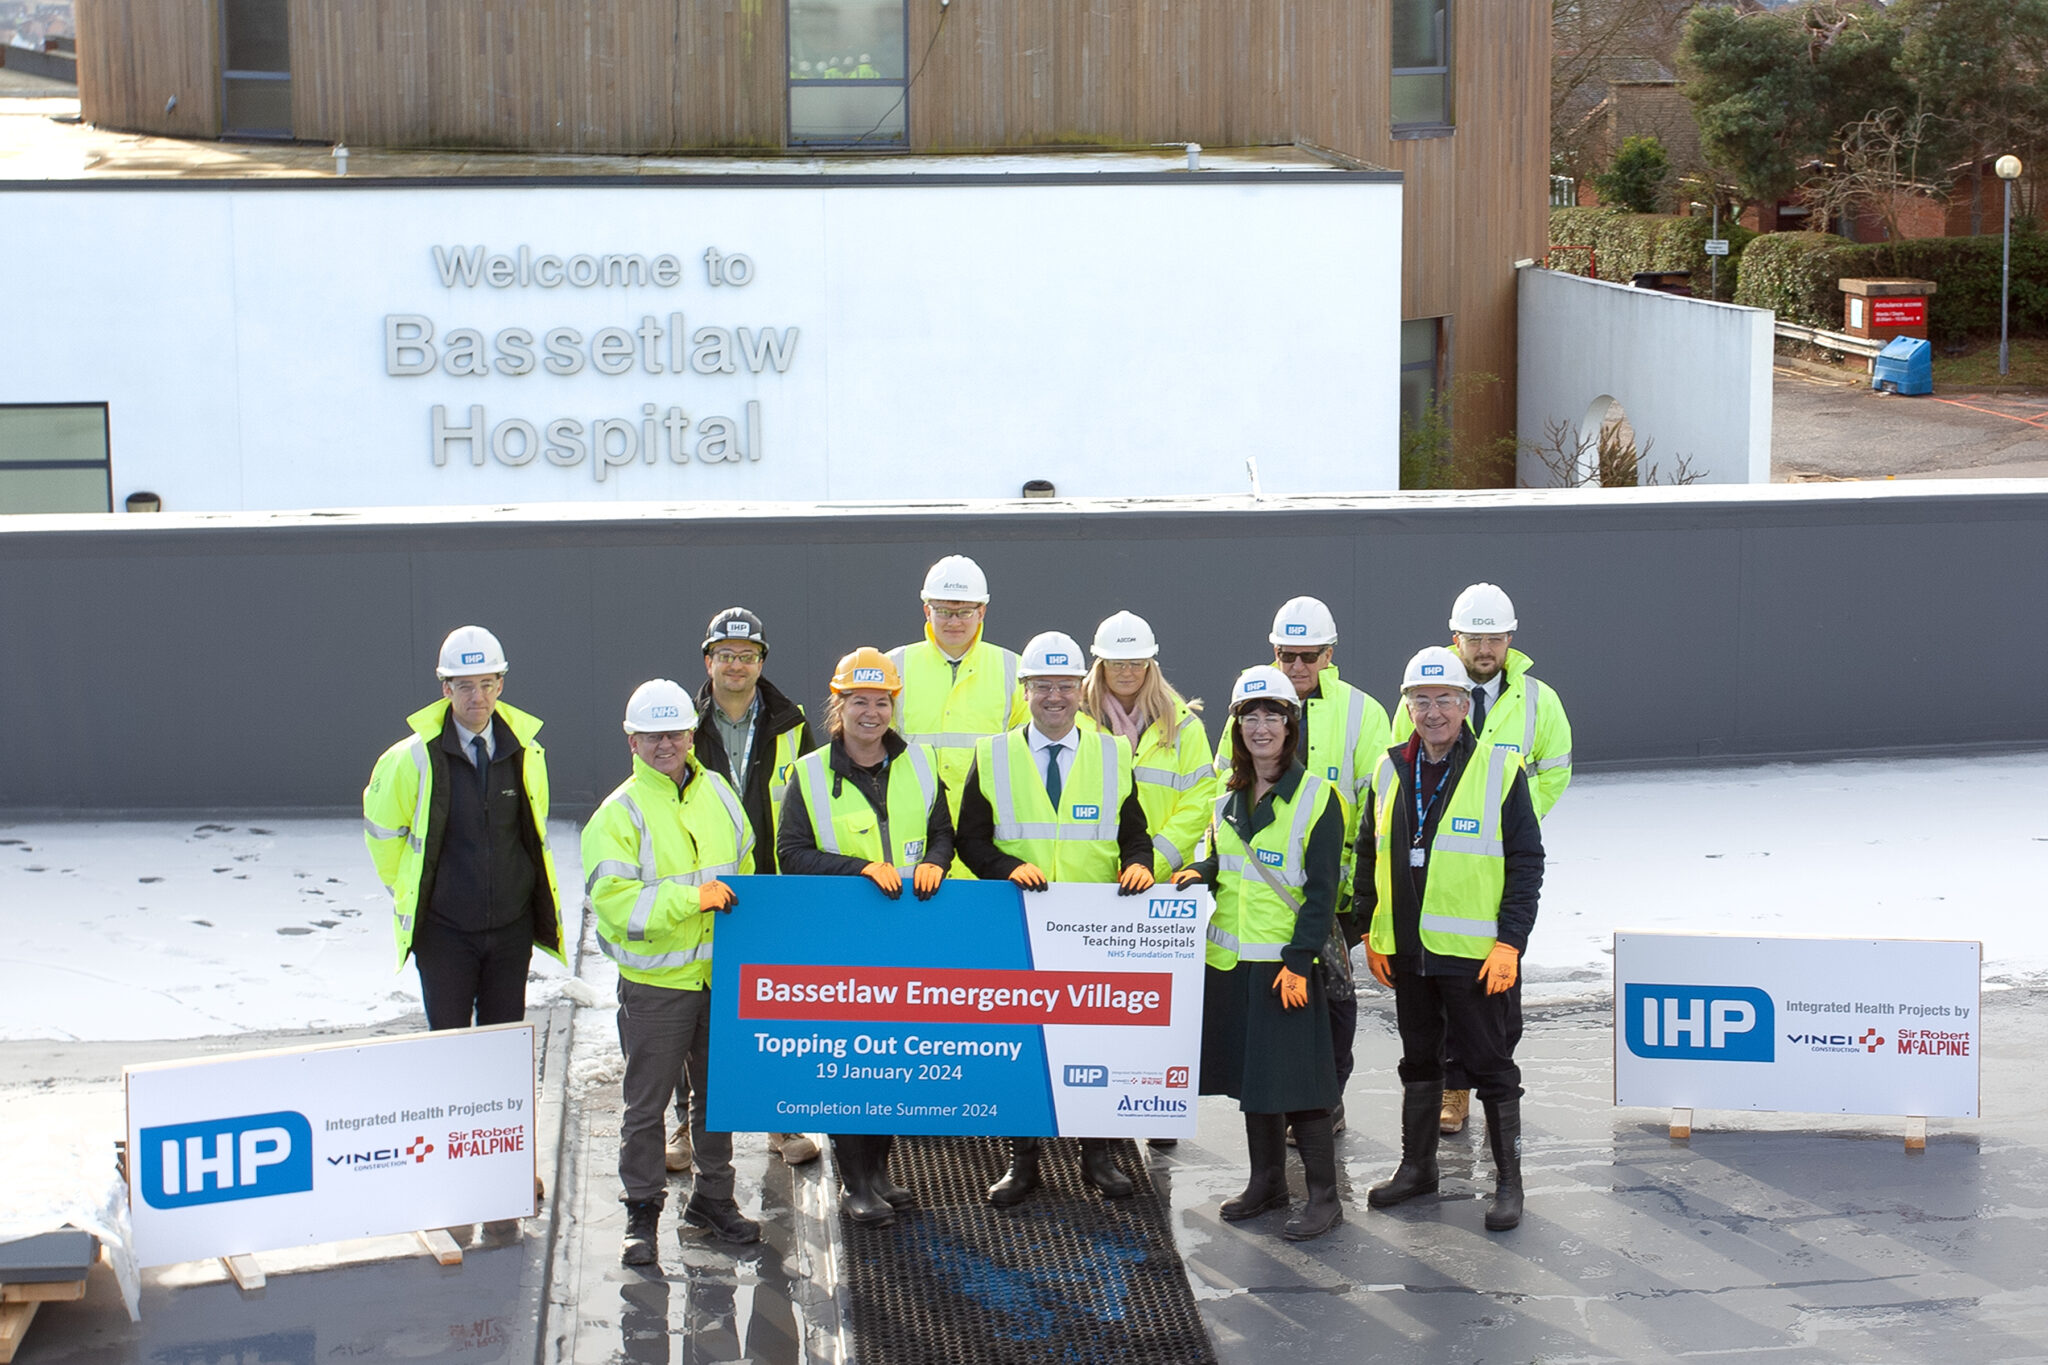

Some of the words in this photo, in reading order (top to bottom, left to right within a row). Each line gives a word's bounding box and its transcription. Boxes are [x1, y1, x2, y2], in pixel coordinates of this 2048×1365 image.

[431, 244, 681, 288] Welcome
[703, 246, 754, 287] to
[384, 312, 799, 376] Bassetlaw
[431, 400, 761, 482] Hospital
[1288, 626, 1305, 635] IHP
[464, 654, 482, 664] IHP
[1049, 655, 1066, 664] IHP
[855, 670, 883, 682] NHS
[1424, 666, 1442, 676] IHP
[1246, 682, 1264, 691] IHP
[652, 706, 678, 718] NHS
[1075, 806, 1097, 818] IHP
[1455, 820, 1477, 831] IHP
[1259, 851, 1281, 864] IHP
[1150, 900, 1196, 918] NHS
[1046, 920, 1108, 932] Doncaster
[1110, 922, 1134, 934] and
[1136, 922, 1196, 934] Bassetlaw
[1083, 935, 1136, 950] Teaching
[1140, 937, 1196, 950] Hospitals
[1108, 950, 1125, 958] NHS
[1126, 950, 1173, 958] Foundation
[756, 978, 898, 1004] Bassetlaw
[906, 981, 1060, 1012] Emergency
[1067, 983, 1160, 1013] Village
[1786, 1001, 1850, 1014] Integrated
[1855, 1002, 1895, 1014] Health
[1900, 1004, 1950, 1017] Projects
[1954, 1006, 1970, 1019] by
[1643, 997, 1756, 1049] IHP
[1787, 1034, 1852, 1046] VINCI
[1898, 1029, 1917, 1038] Sir
[1920, 1030, 1970, 1040] Robert
[754, 1033, 847, 1059] Topping
[854, 1034, 897, 1055] Out
[904, 1036, 1022, 1061] Ceremony
[816, 1063, 838, 1079] 19
[843, 1064, 913, 1083] January
[918, 1065, 963, 1080] 2024
[1069, 1068, 1103, 1084] IHP
[1169, 1070, 1187, 1084] 20
[776, 1100, 861, 1119] Completion
[865, 1102, 893, 1116] late
[896, 1103, 958, 1118] Summer
[961, 1104, 998, 1118] 2024
[1117, 1094, 1187, 1112] Archus
[325, 1111, 396, 1132] Integrated
[400, 1106, 444, 1122] Health
[448, 1100, 504, 1118] Projects
[507, 1098, 524, 1112] by
[448, 1131, 468, 1143] Sir
[472, 1124, 524, 1140] Robert
[161, 1126, 292, 1196] IHP
[327, 1148, 399, 1166] VINCI
[354, 1160, 408, 1172] CONSTRUCTION
